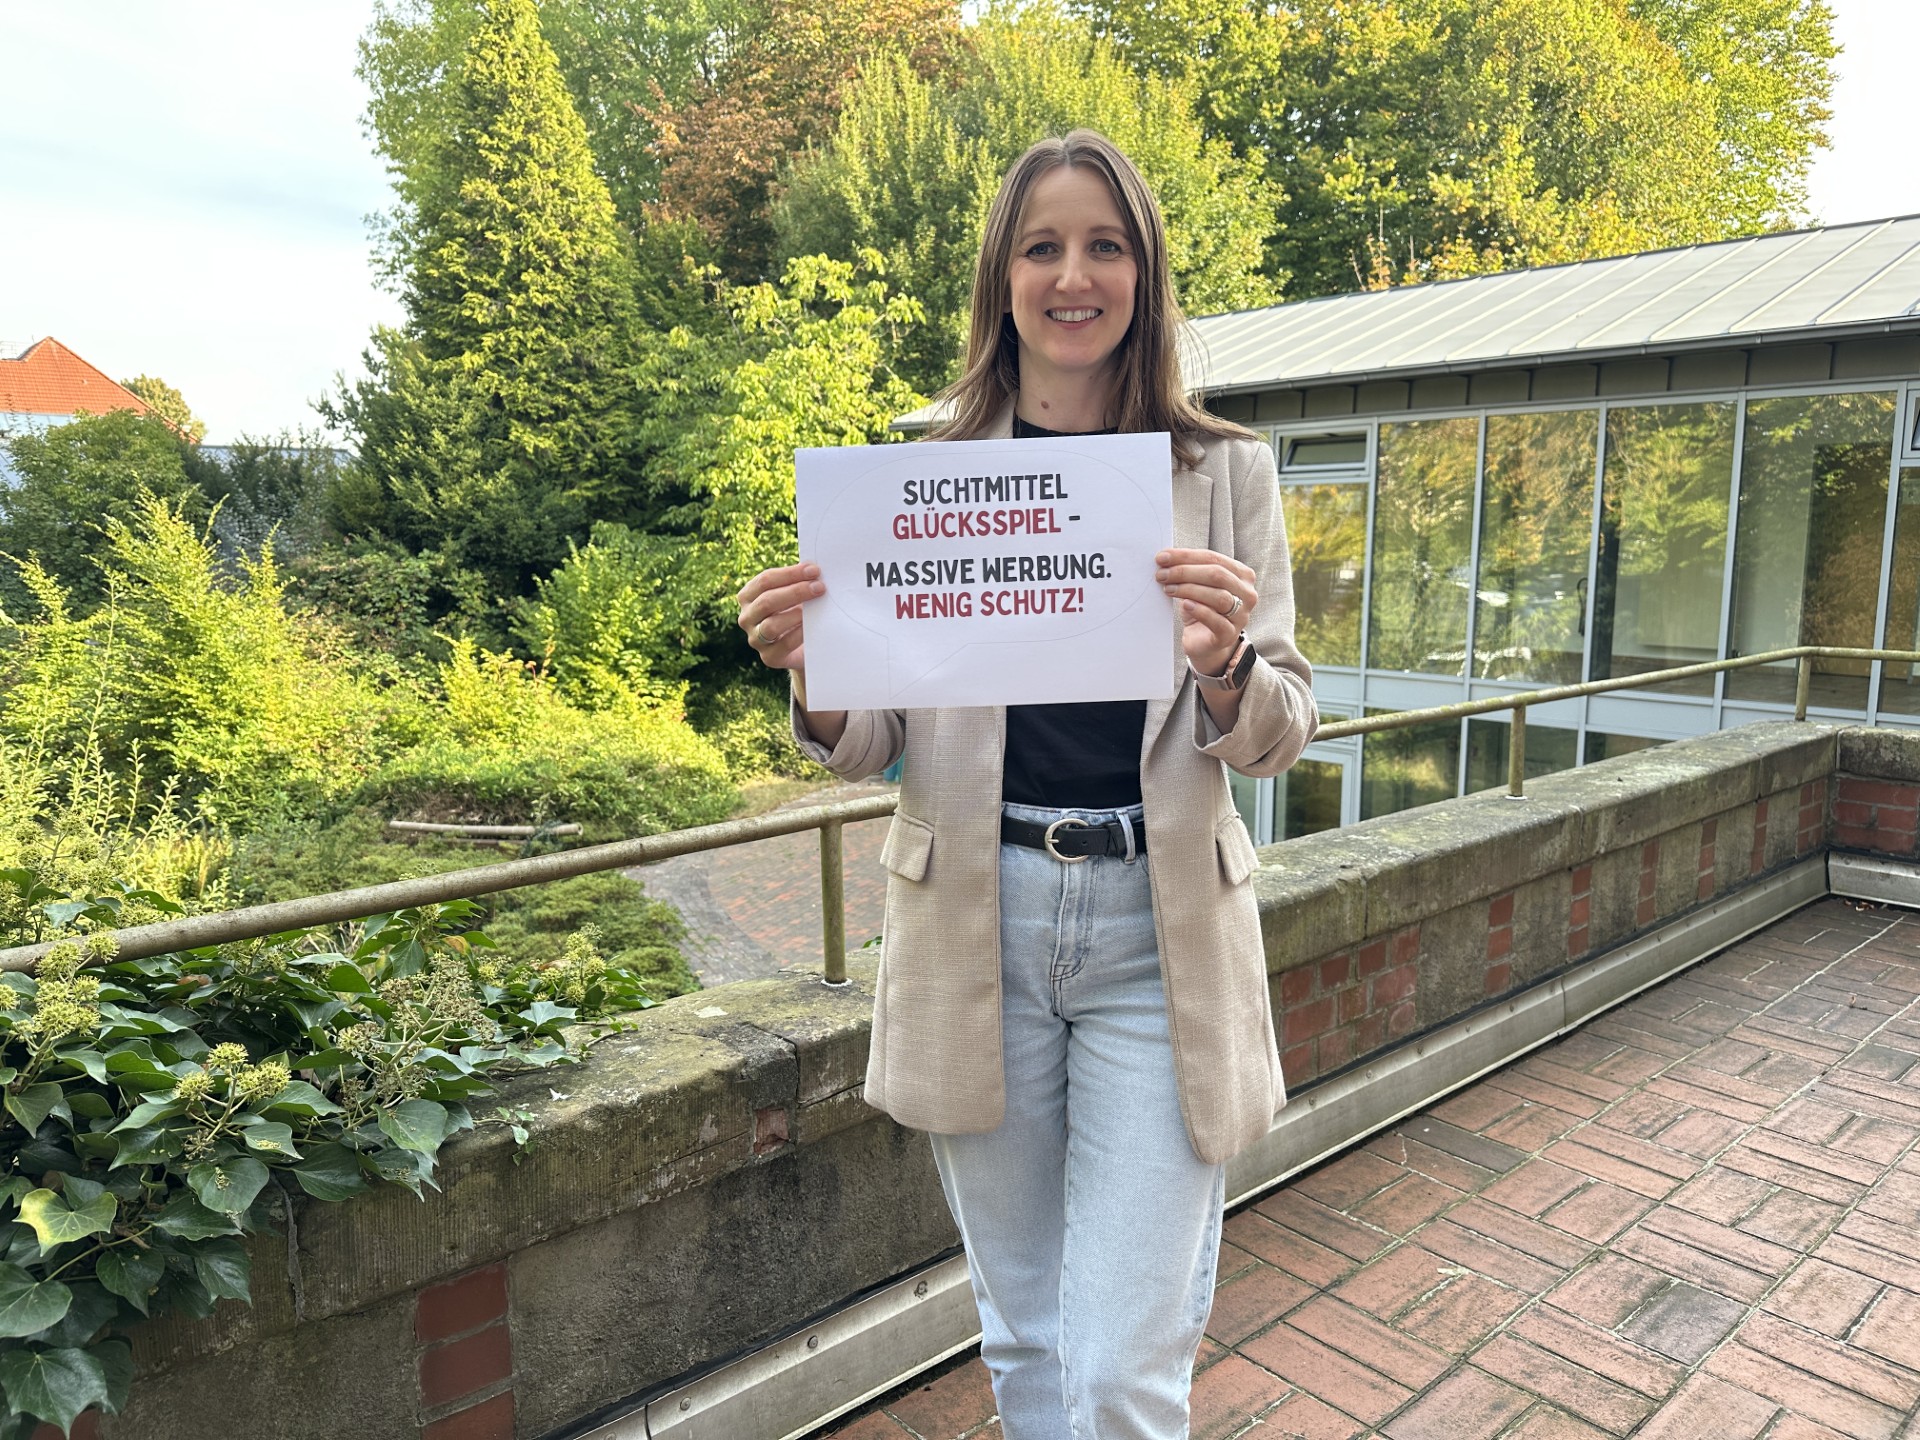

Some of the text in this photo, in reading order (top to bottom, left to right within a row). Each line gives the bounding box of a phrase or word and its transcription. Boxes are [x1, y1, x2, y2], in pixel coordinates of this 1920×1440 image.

[904, 474, 1068, 505] SUCHTMITTEL
[893, 507, 1061, 540] GLÜCKSSPIEL
[866, 553, 1111, 587] MASSIVE WERBUNG.
[896, 588, 1083, 619] WENIG SCHUTZ!
